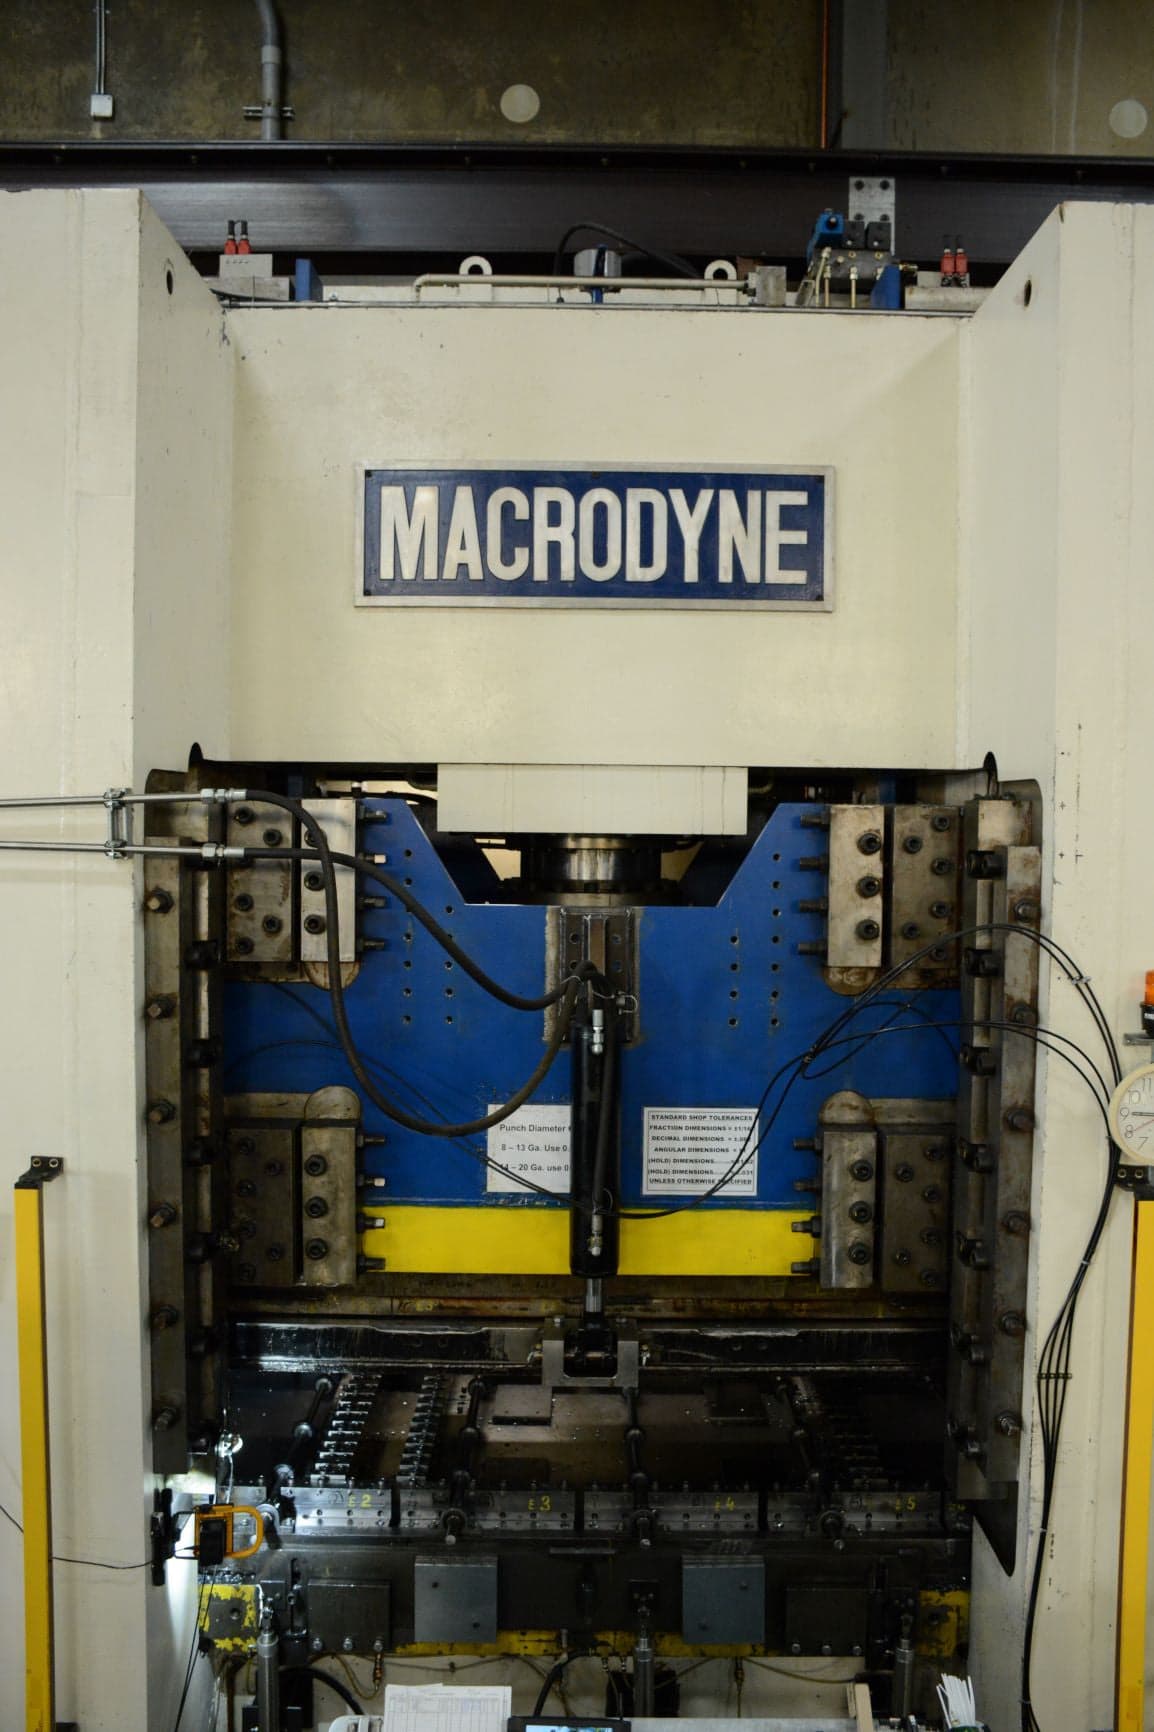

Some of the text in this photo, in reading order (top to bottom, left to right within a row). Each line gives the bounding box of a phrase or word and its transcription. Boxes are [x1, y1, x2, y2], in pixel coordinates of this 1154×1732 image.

[379, 485, 809, 585] MACRODYNE
[1128, 1089, 1141, 1105] 10
[1120, 1107, 1130, 1121] 9
[500, 1124, 526, 1132] Punch
[528, 1124, 566, 1132] Diameter
[1124, 1124, 1134, 1139] 8
[1137, 1137, 1149, 1152] 7
[518, 1163, 529, 1171] 20
[360, 1494, 372, 1509] 2
[540, 1495, 551, 1511] 3
